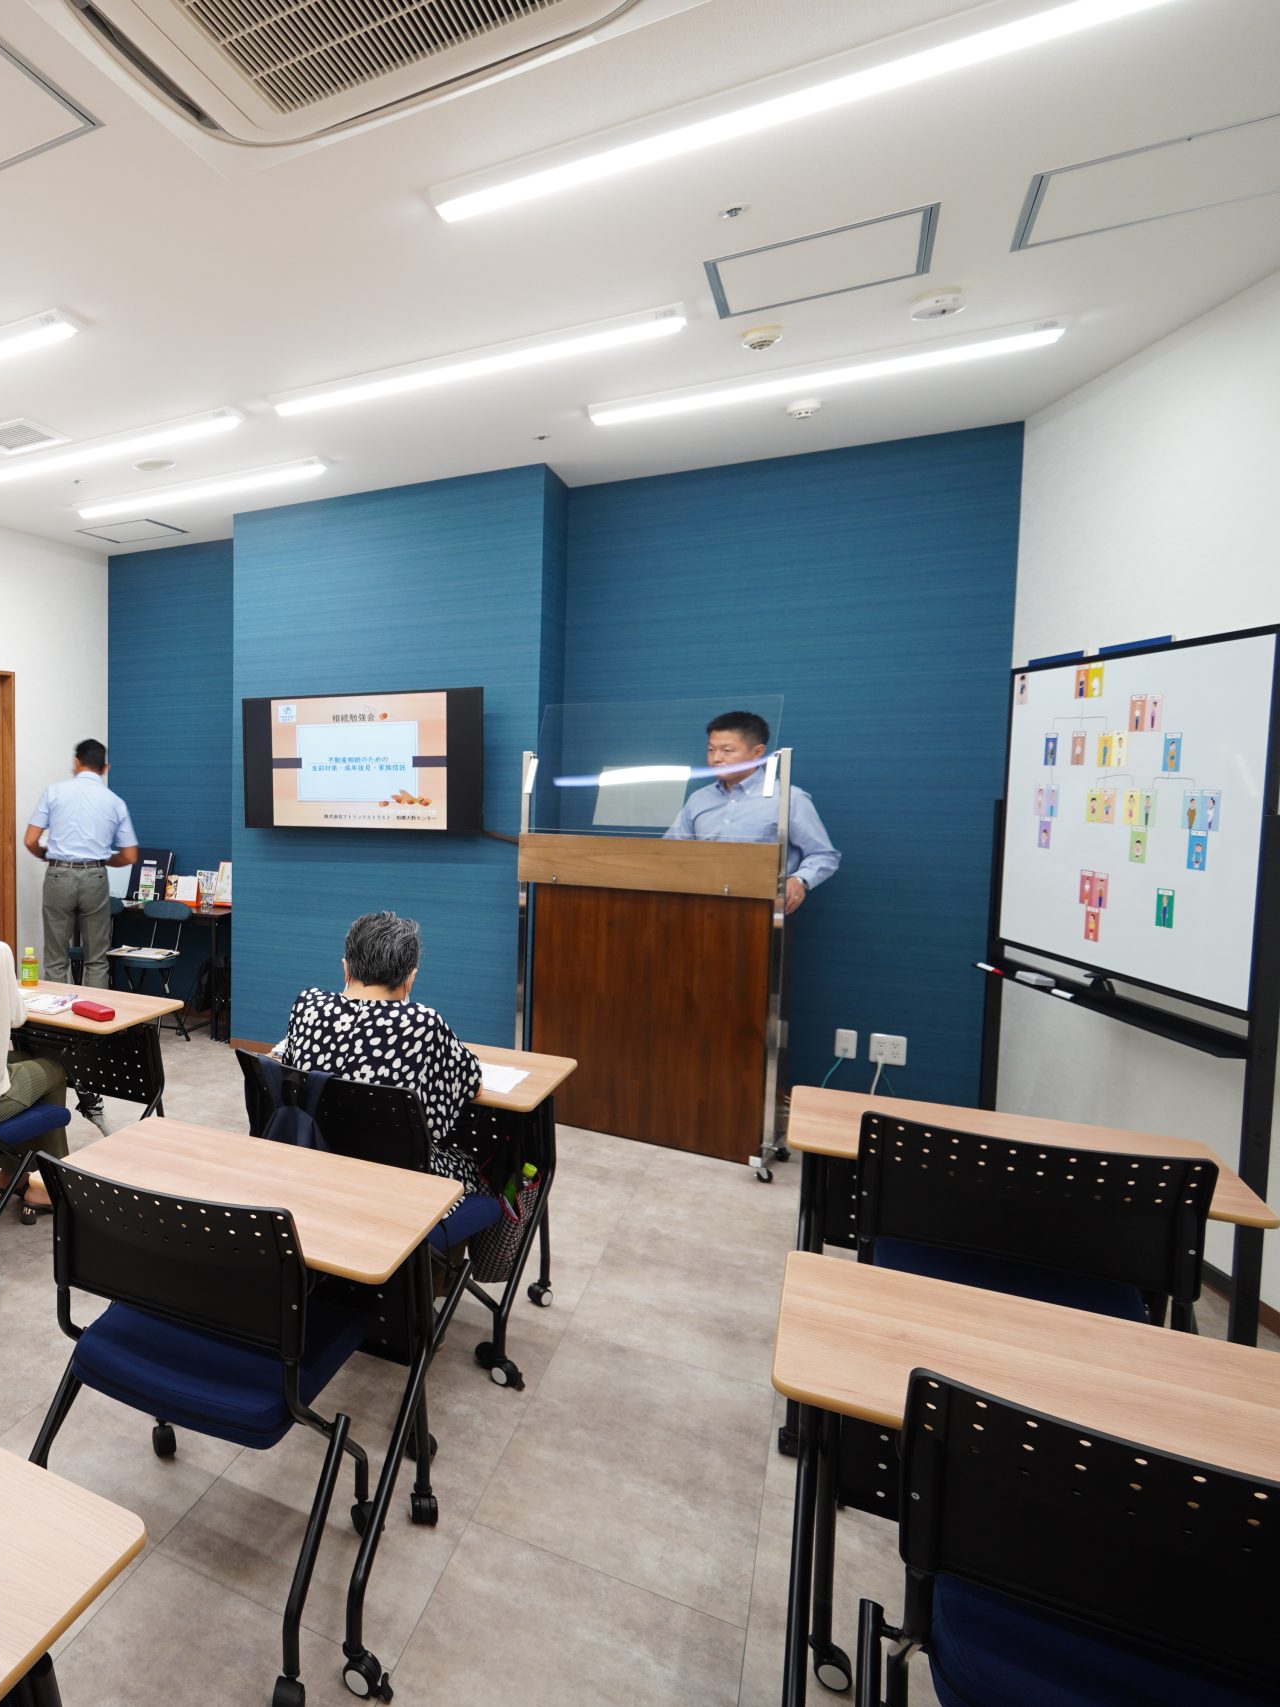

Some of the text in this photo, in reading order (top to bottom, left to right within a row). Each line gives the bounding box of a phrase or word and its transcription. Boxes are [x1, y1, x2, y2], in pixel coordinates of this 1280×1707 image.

[332, 712, 376, 723] 相続勉強会
